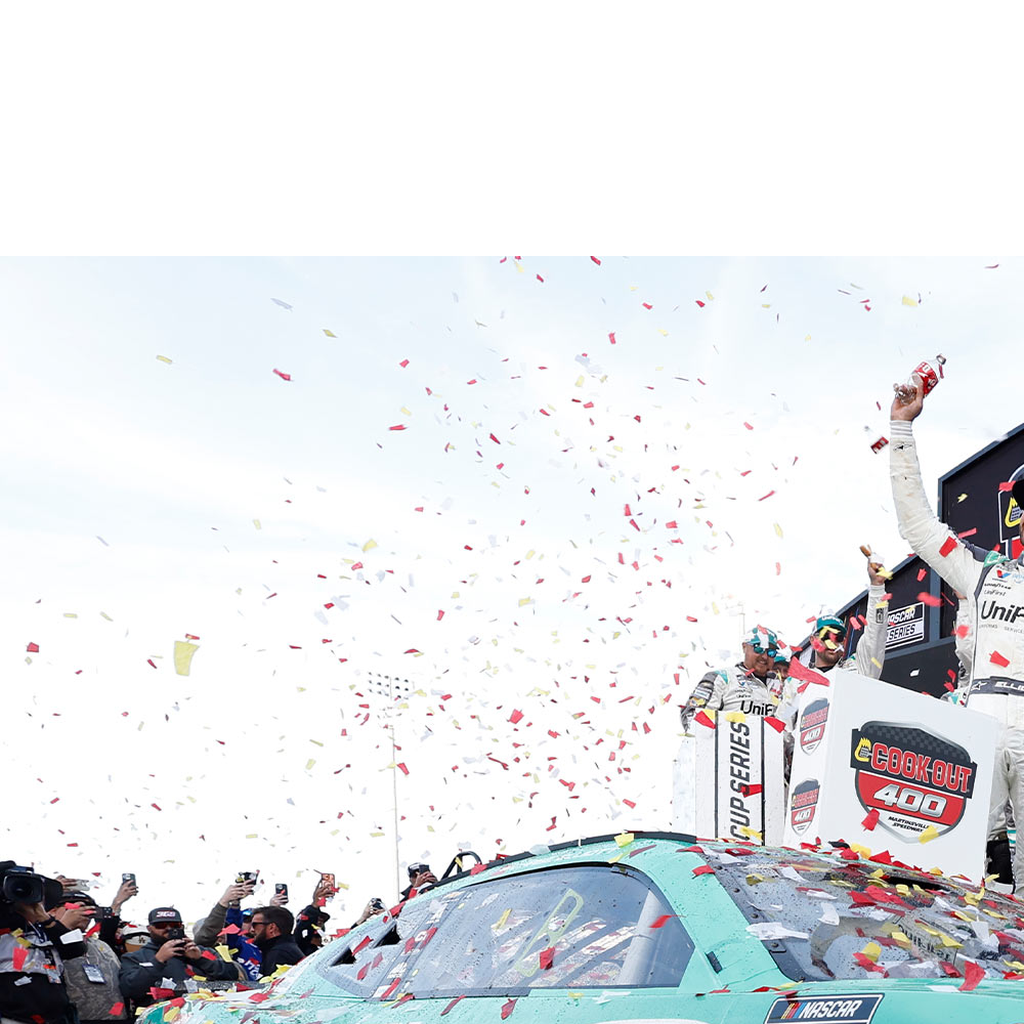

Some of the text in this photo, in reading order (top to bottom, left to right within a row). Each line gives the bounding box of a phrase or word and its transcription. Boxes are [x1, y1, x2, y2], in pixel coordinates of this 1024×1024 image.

[888, 624, 916, 640] SERIES
[730, 721, 751, 793] SERIES
[871, 742, 973, 794] COOK OUT
[873, 783, 947, 818] 400
[730, 796, 751, 841] CUP
[888, 815, 931, 829] MARTINSVILL
[797, 1000, 863, 1020] NASCAR
